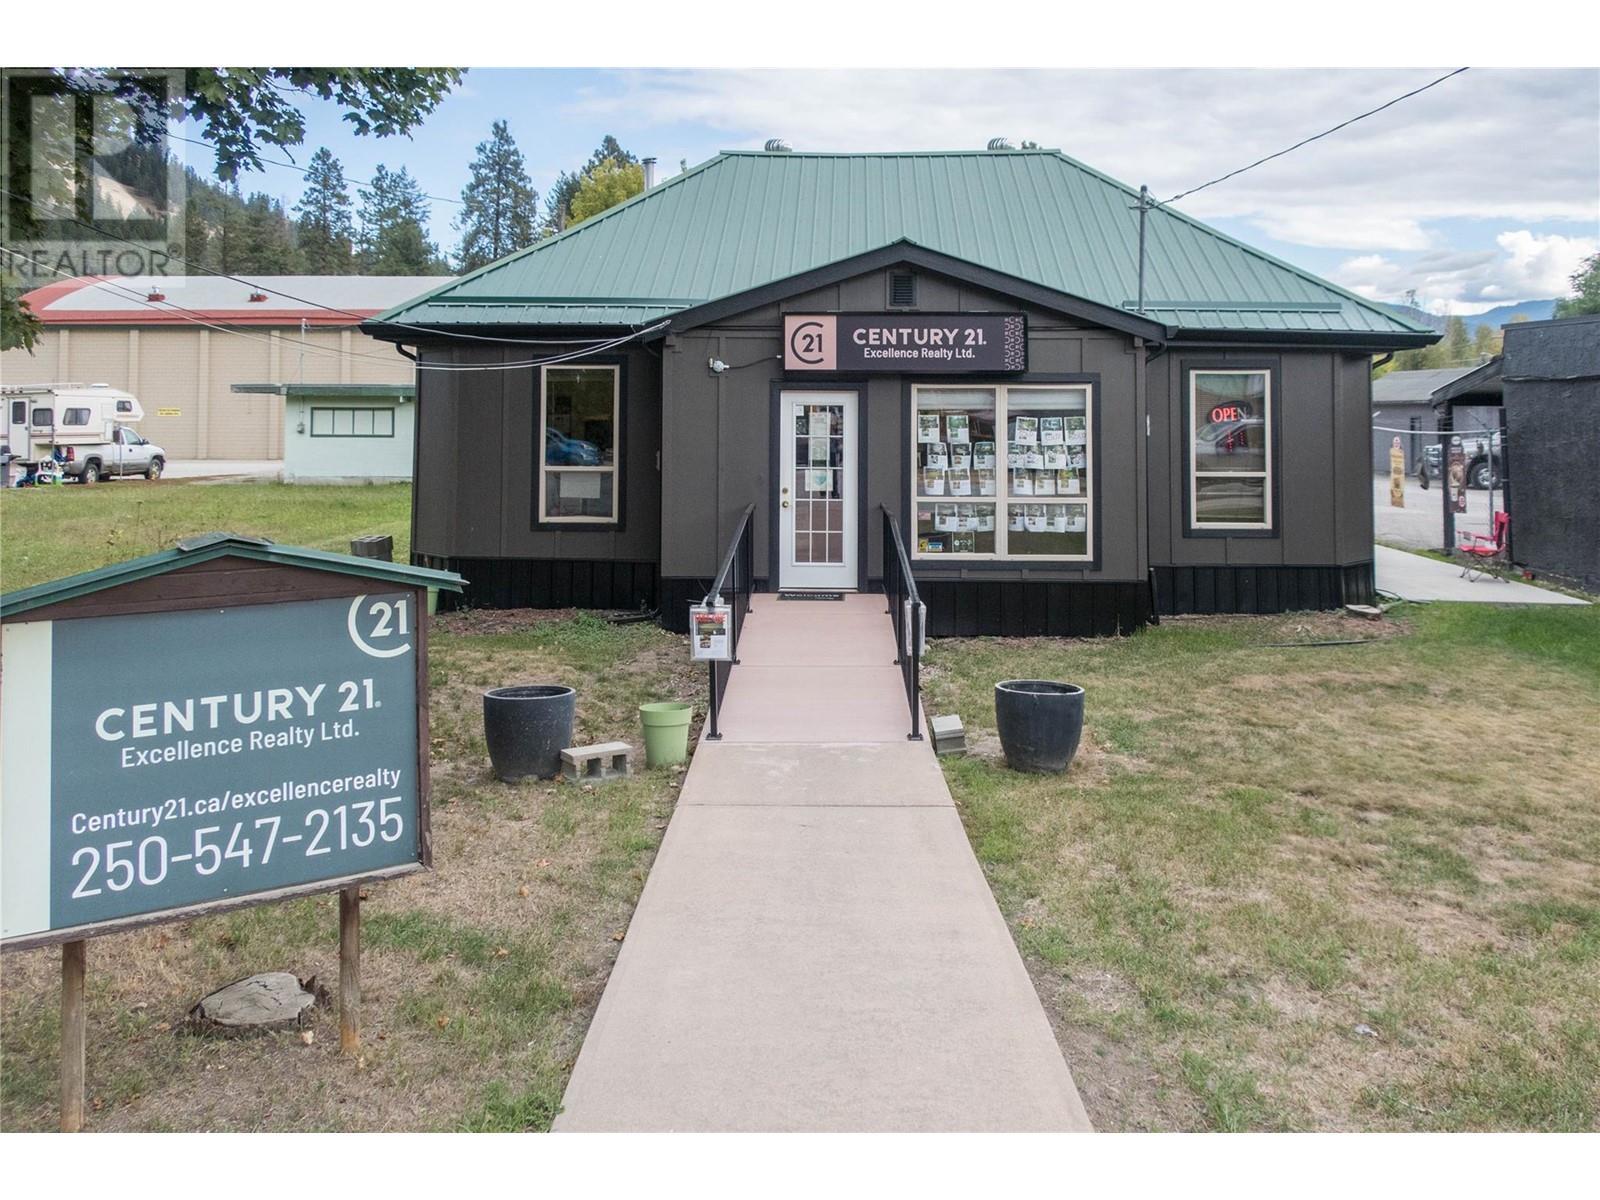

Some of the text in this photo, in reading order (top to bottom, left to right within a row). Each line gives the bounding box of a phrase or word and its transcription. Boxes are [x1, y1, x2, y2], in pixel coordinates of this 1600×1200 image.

[852, 328, 960, 346] CENTURY
[863, 347, 976, 361] Excellence Realty Ltd.
[1211, 406, 1248, 423] OPEN
[95, 683, 327, 741] CENTURY
[121, 718, 360, 768] Excellence Realty Ltd.
[71, 768, 402, 835] Century21.ca/excellencerealty
[71, 796, 404, 899] 250-547-2135
